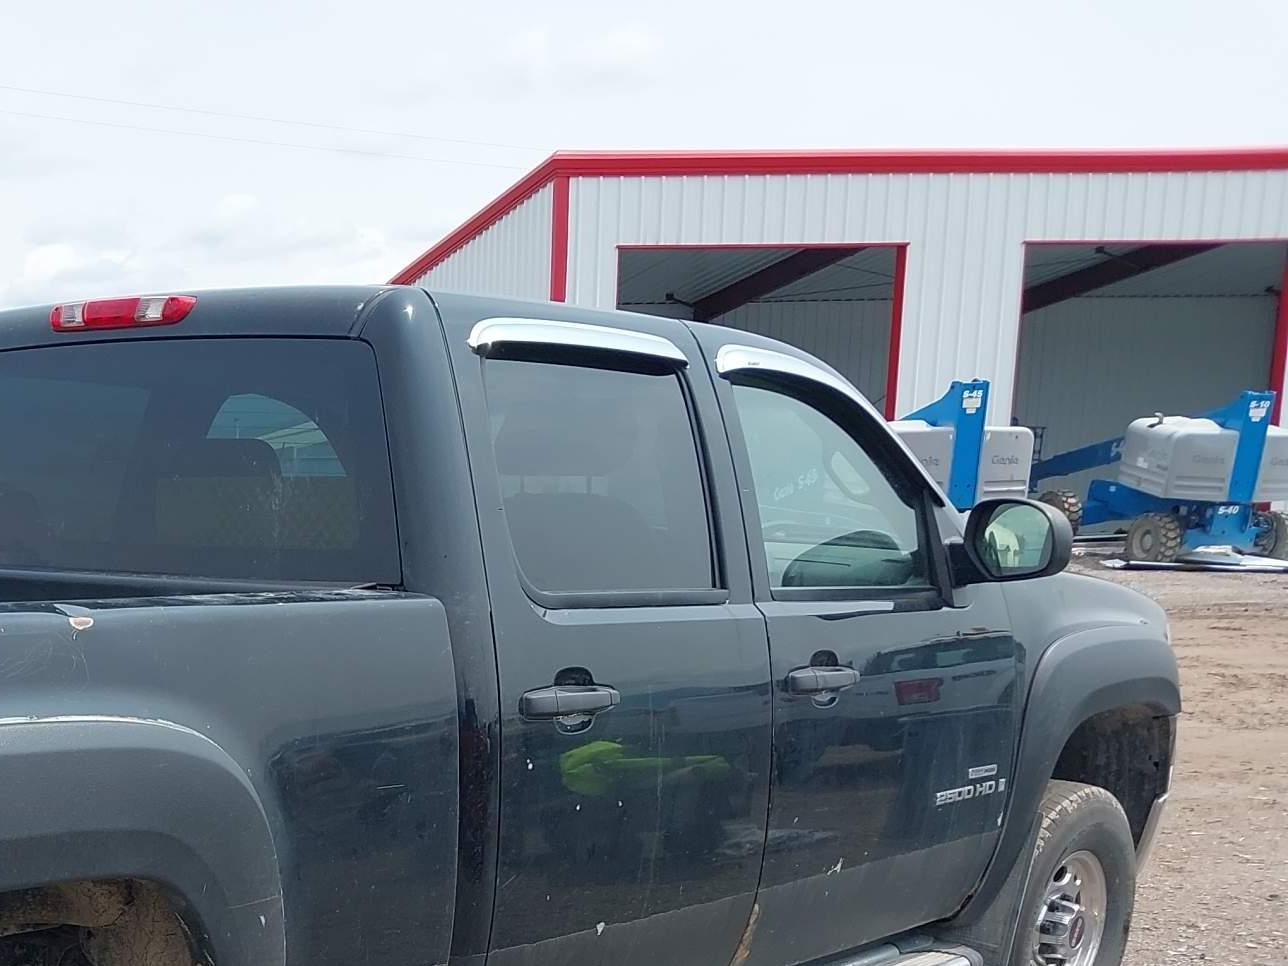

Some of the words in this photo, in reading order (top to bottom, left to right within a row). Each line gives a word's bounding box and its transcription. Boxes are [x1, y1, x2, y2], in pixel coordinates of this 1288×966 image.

[962, 389, 984, 399] S-45
[991, 454, 1019, 465] Genie
[935, 785, 974, 806] 2500
[974, 780, 996, 797] HD
